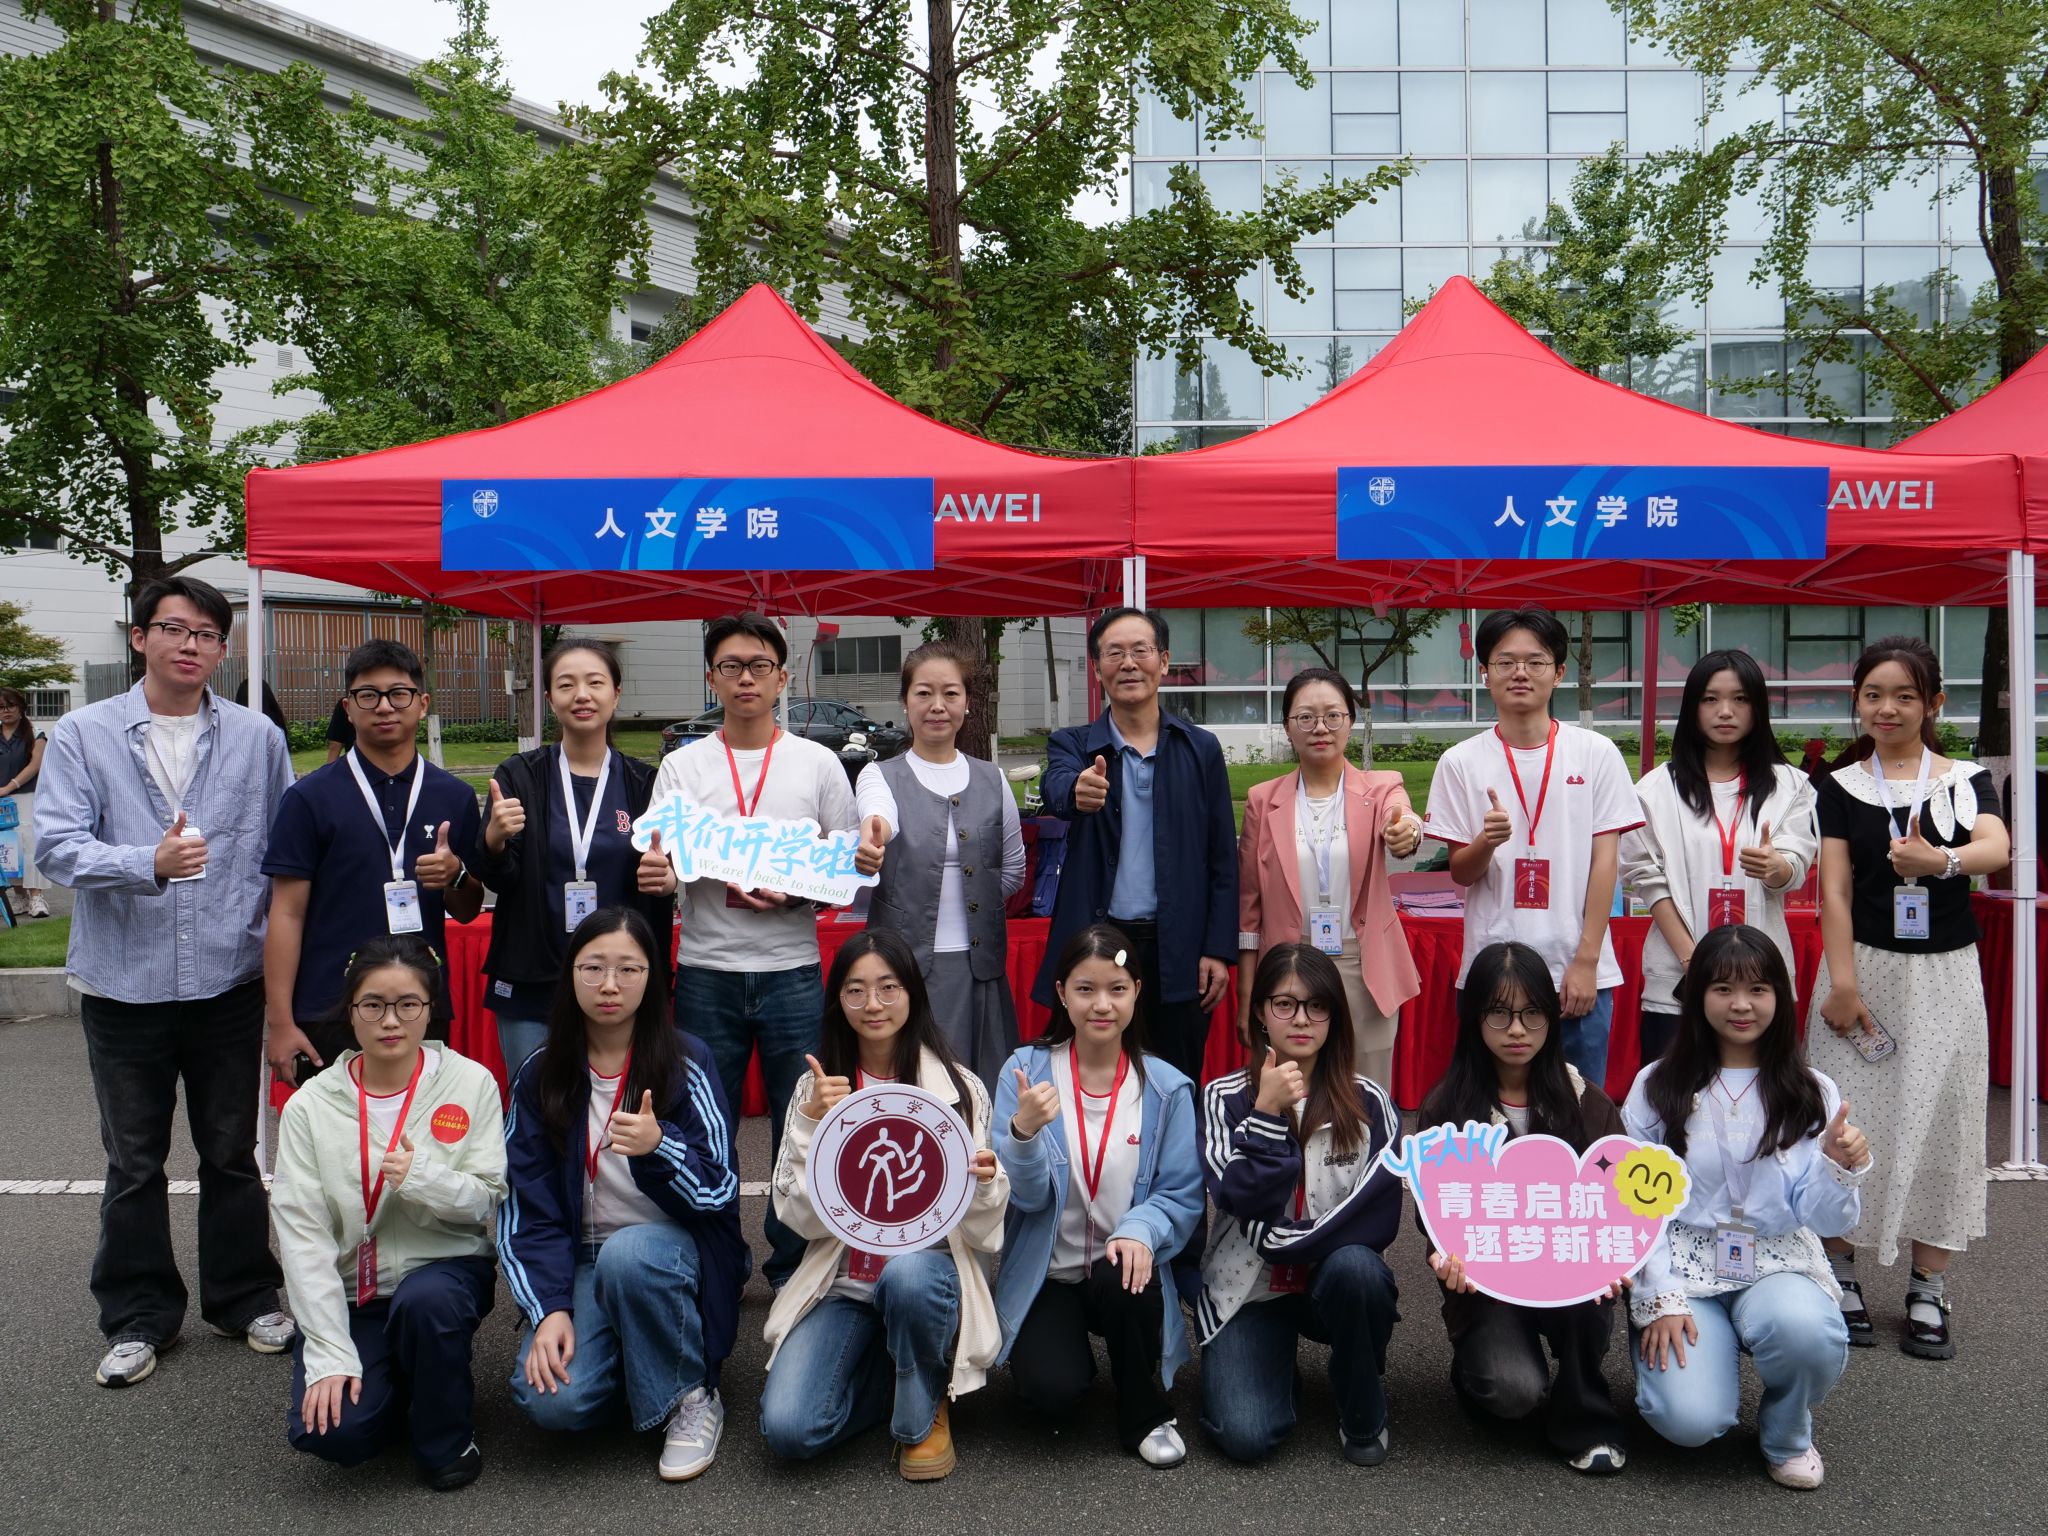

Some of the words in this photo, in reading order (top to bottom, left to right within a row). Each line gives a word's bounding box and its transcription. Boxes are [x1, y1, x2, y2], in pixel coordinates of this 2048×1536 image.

[934, 493, 1041, 523] AWEI
[1493, 495, 1679, 529] 人文学院
[1828, 480, 1934, 510] AWEI
[594, 507, 779, 540] 人文学院
[616, 810, 631, 832] B
[640, 795, 873, 883] 我们开学啦
[698, 858, 719, 873] We
[721, 866, 745, 878] are
[754, 870, 786, 887] back
[791, 879, 804, 891] to
[807, 884, 850, 900] school
[840, 1098, 953, 1141] 人文学院
[1437, 1181, 1608, 1220] 青春启航
[1463, 1225, 1636, 1264] 逐梦新程
